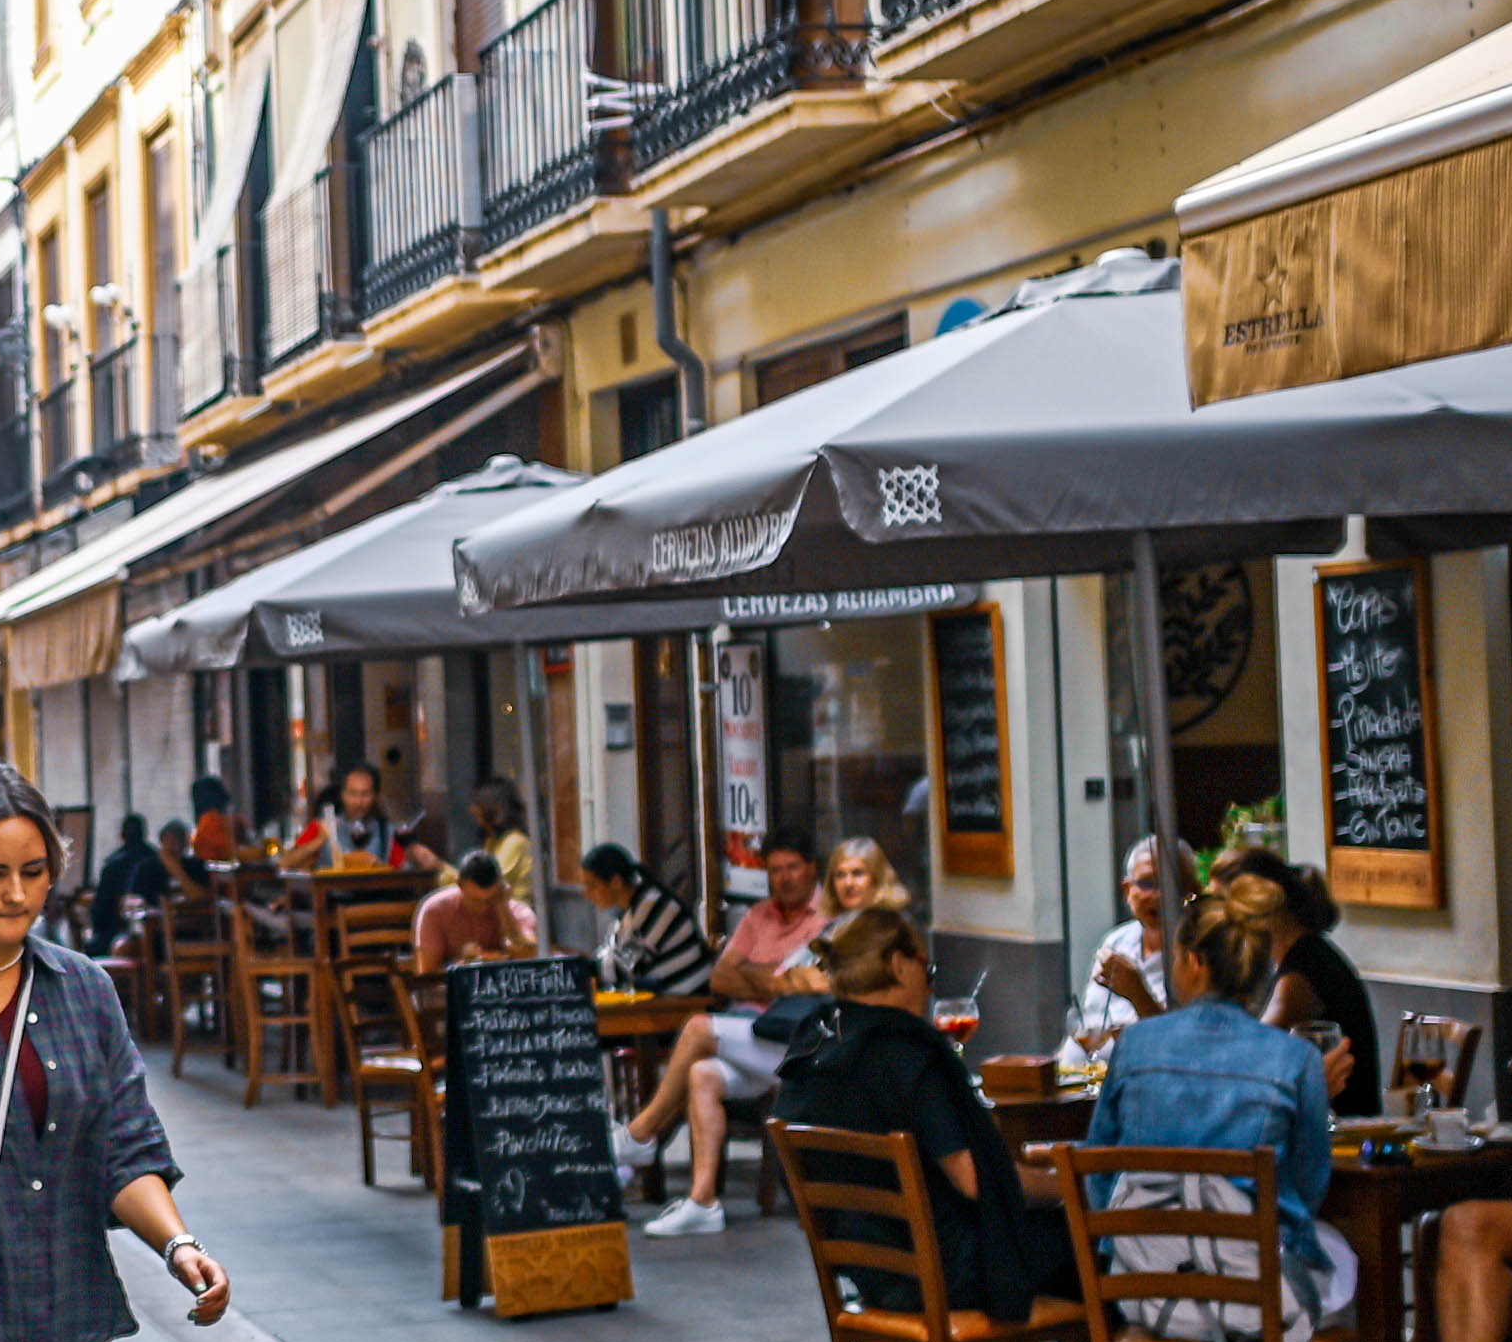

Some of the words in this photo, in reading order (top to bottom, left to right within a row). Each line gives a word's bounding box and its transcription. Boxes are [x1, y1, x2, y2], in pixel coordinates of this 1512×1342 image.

[1224, 303, 1324, 347] ESTRELLA
[652, 525, 716, 573] CERVEZAS
[724, 593, 828, 619] CERVEZAS
[836, 583, 956, 611] ALHAMBRA
[731, 673, 753, 717] 10
